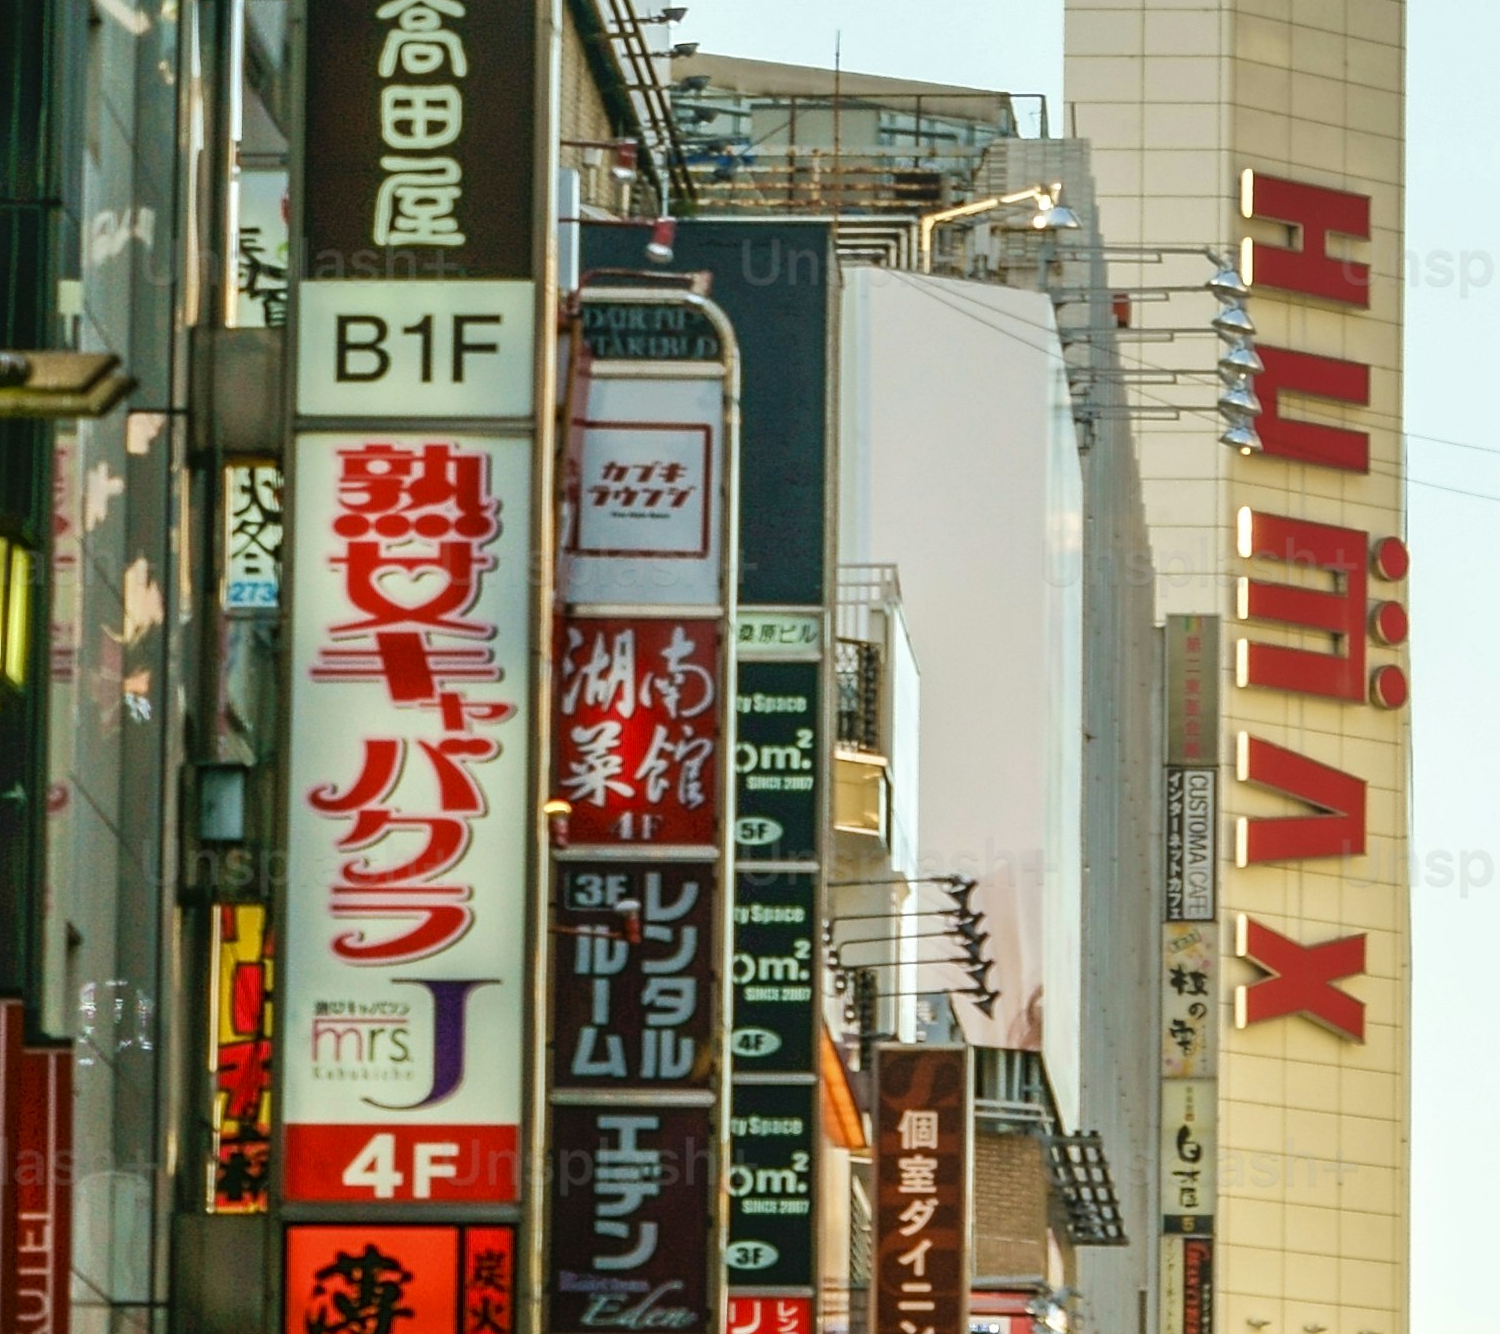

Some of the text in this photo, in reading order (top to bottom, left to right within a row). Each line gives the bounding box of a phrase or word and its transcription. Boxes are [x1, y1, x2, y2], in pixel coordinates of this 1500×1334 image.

[334, 315, 503, 384] B1F
[738, 622, 819, 646] 桑原ビル
[308, 443, 518, 965] 熟女キャバクラ
[560, 624, 716, 721] 湖南
[564, 718, 715, 810] 菜館
[742, 821, 769, 840] 5F
[640, 871, 699, 1079] レンタル
[737, 1033, 766, 1052] 4F
[341, 1132, 460, 1199] 4F
[592, 1115, 661, 1270] エデン
[735, 1246, 764, 1265] 3F
